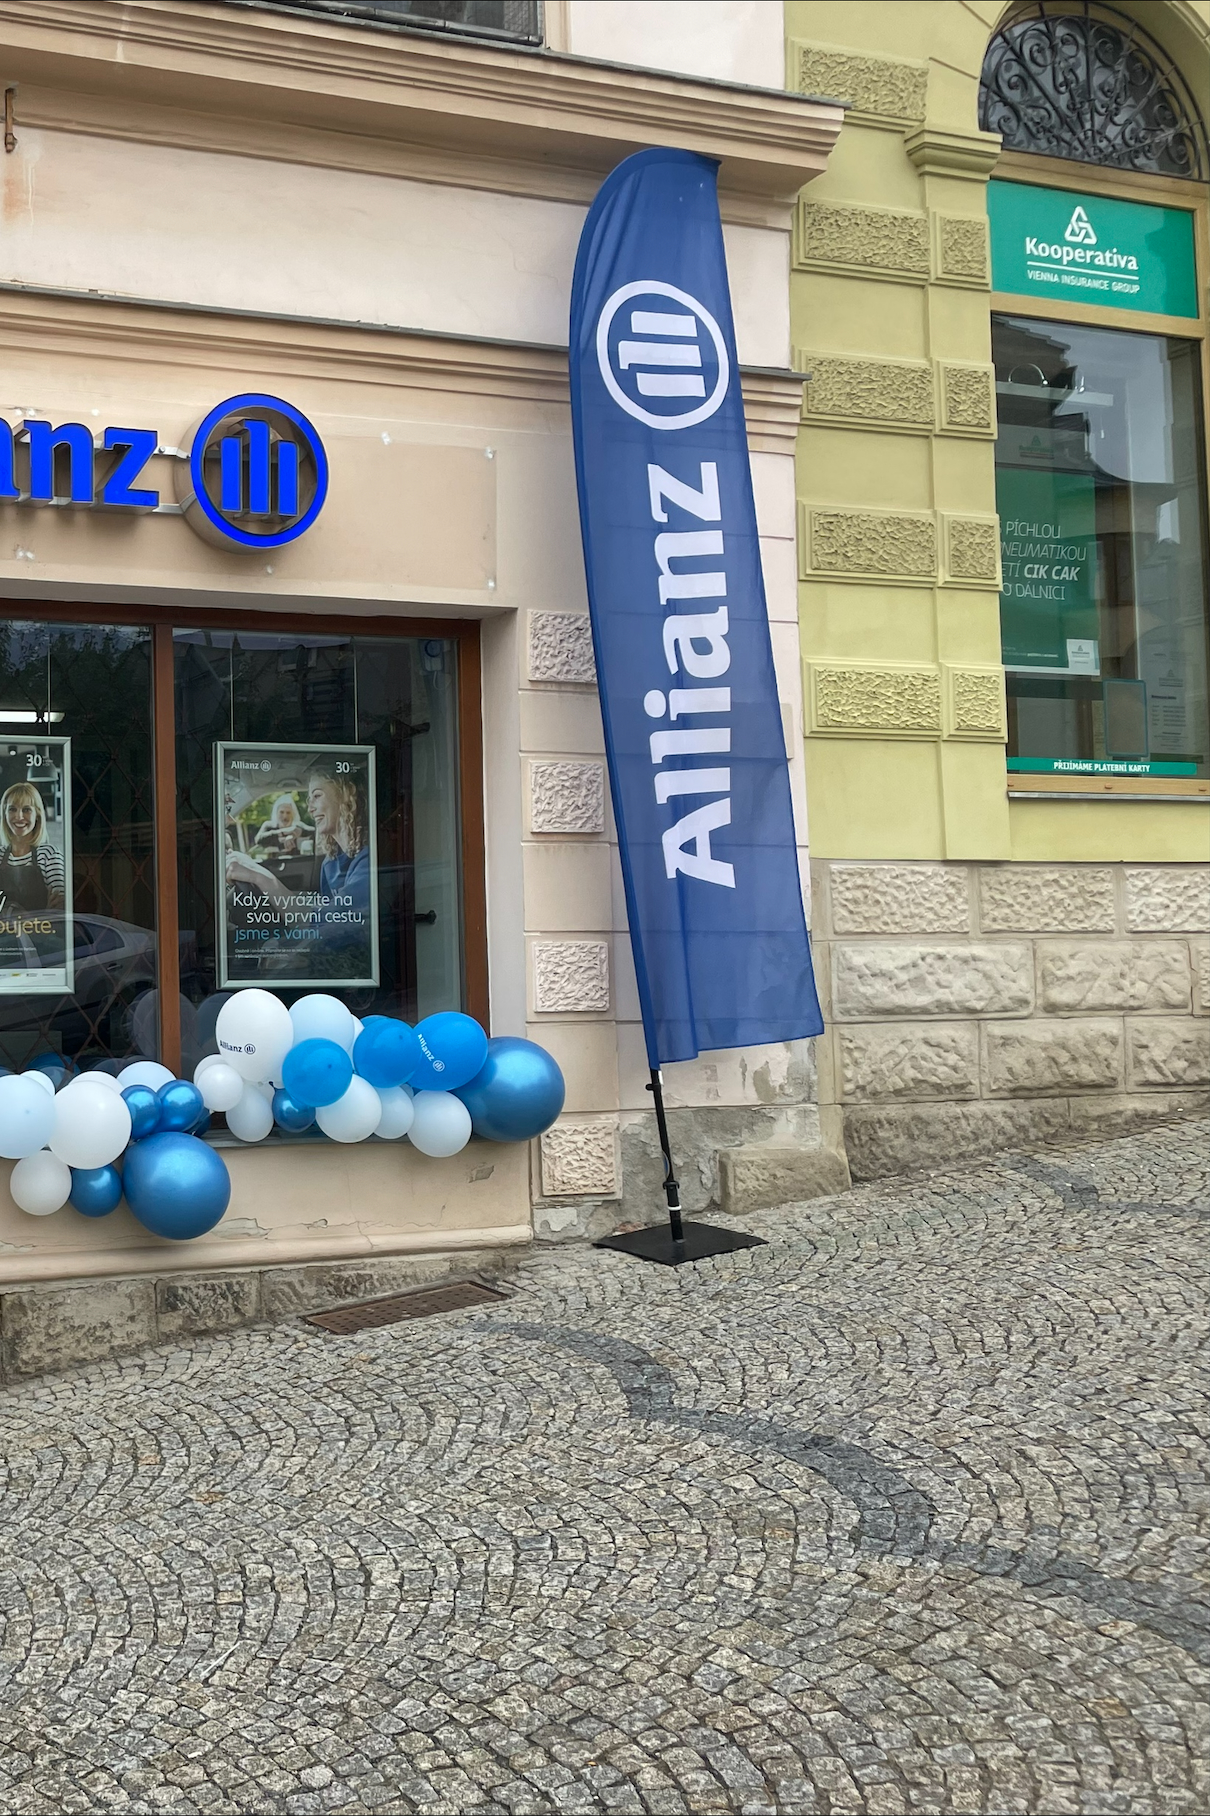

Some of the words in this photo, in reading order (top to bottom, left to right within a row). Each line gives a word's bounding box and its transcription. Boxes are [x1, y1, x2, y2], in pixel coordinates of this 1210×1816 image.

[1025, 236, 1139, 270] Kooperativa
[1027, 269, 1059, 283] VIENNA
[1061, 274, 1110, 290] INSURANCE
[1111, 281, 1140, 294] GROUP
[1006, 519, 1061, 539] PÍCHLOU
[1000, 541, 1087, 561] NEUMATIKOU
[1024, 564, 1049, 579] CIK
[1051, 565, 1081, 581] CAK
[1015, 581, 1065, 600] DÁLNICI
[643, 461, 737, 889] Allianz
[26, 754, 42, 767] 30
[231, 761, 259, 770] Allianz
[335, 761, 350, 773] 30
[1053, 759, 1092, 771] PŘIJÍMÁME
[1094, 762, 1127, 772] PLATEBNÍ
[1128, 764, 1150, 772] KARTY
[233, 891, 270, 909] Když
[273, 891, 330, 909] vyrážíte
[334, 895, 352, 907] na
[246, 912, 281, 923] svou
[284, 908, 321, 926] první
[324, 910, 365, 925] cestu,
[234, 925, 270, 943] jsme
[273, 928, 280, 940] s
[284, 925, 323, 940] vámi.
